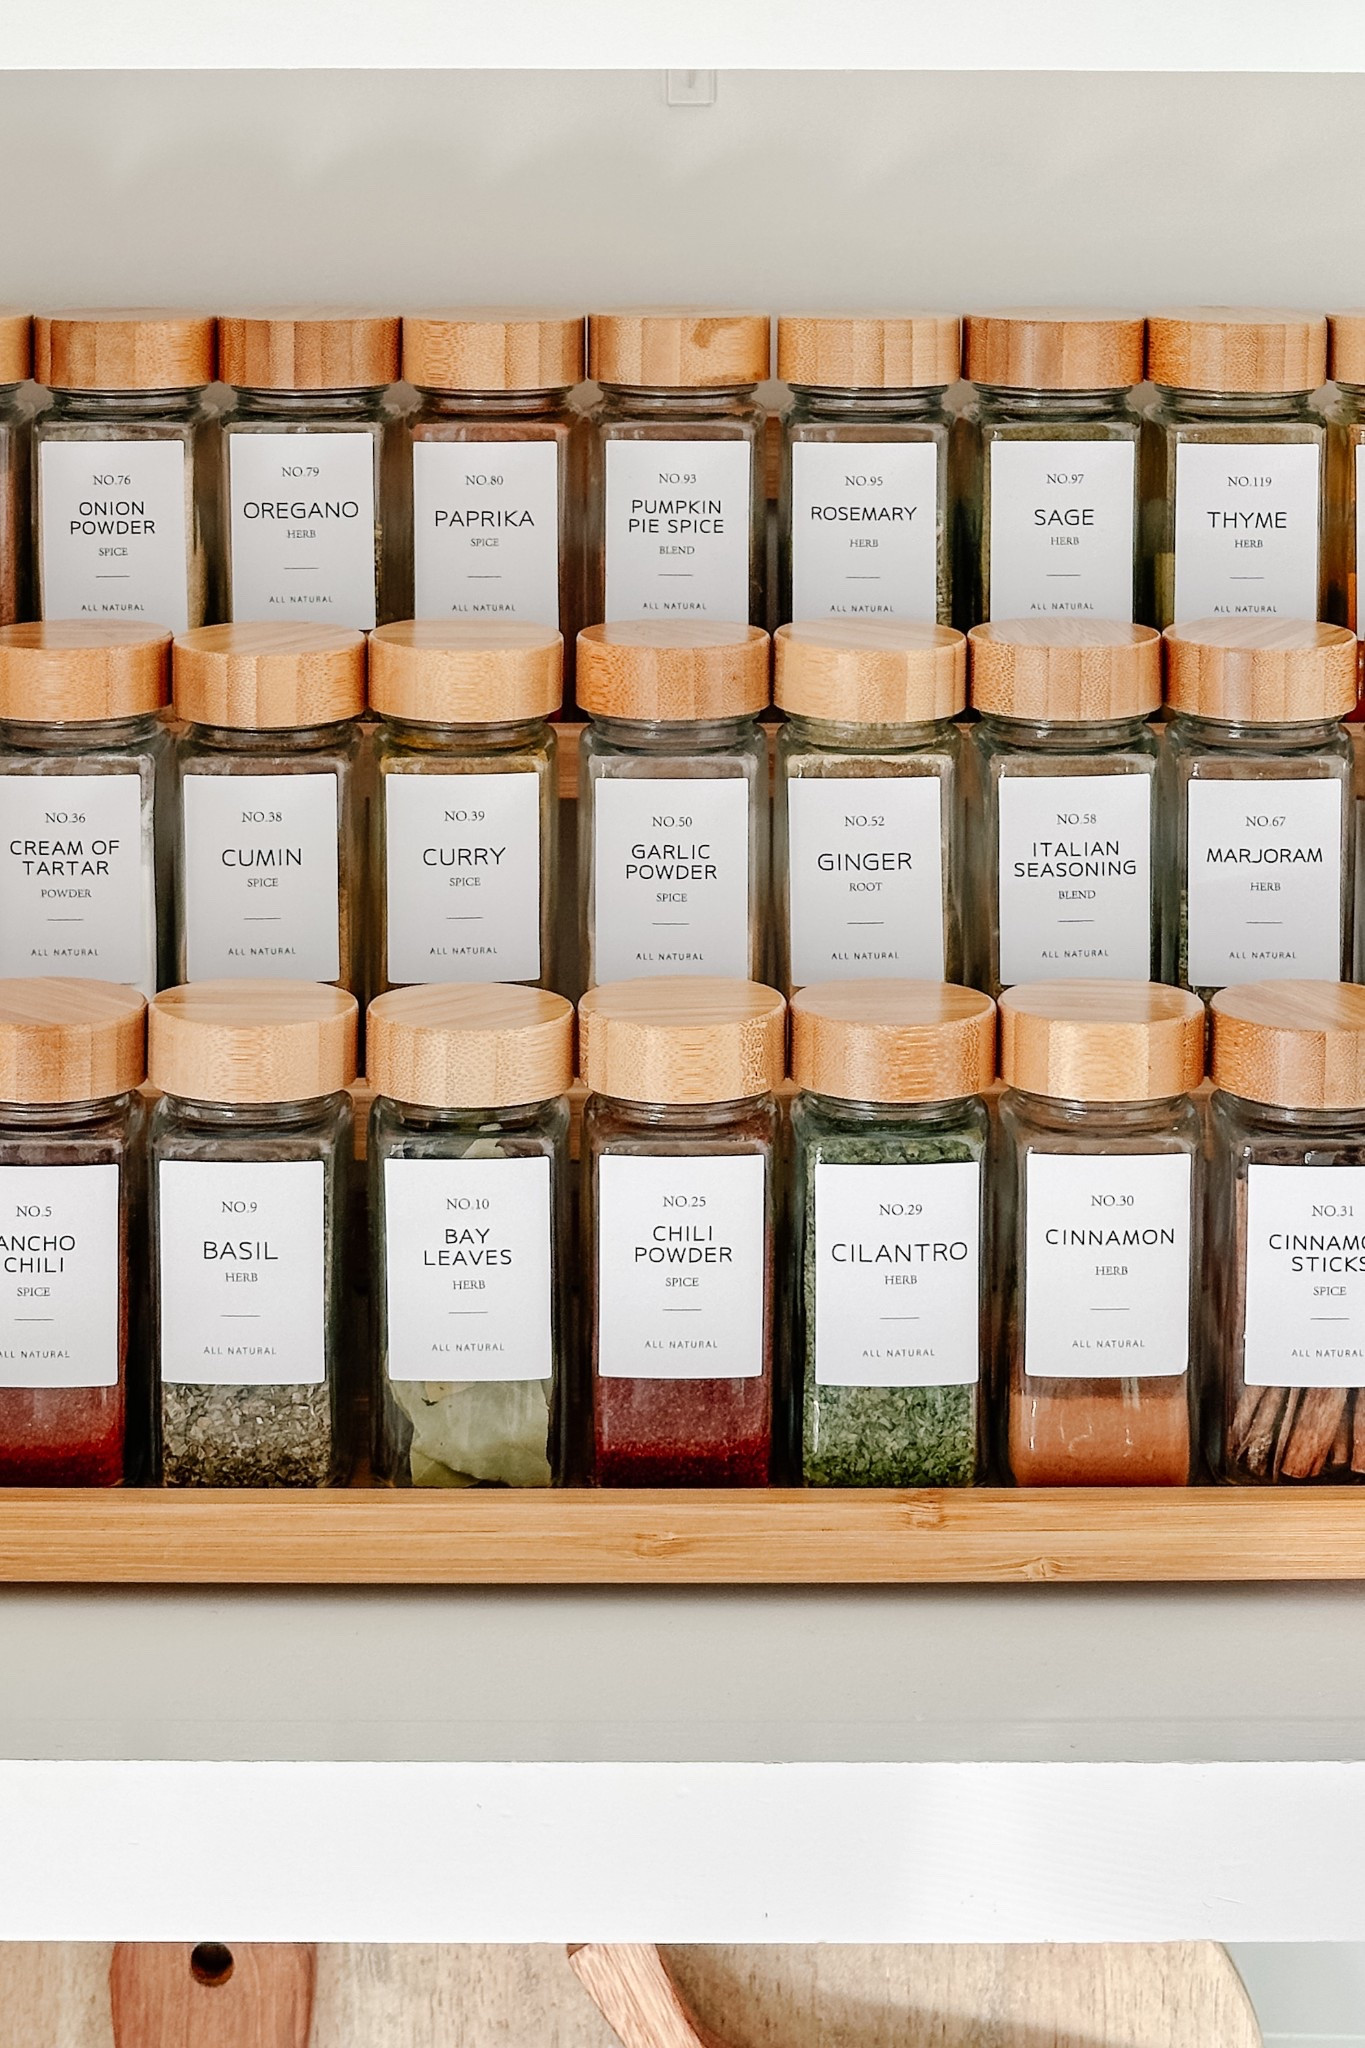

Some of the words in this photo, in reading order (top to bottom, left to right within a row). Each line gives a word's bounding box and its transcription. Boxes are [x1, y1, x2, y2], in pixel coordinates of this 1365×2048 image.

[281, 466, 320, 478] NO.79
[92, 474, 132, 486] NO.76
[465, 474, 504, 486] NO.80
[658, 472, 697, 485] NO.93
[844, 475, 884, 487] NO.95
[1046, 473, 1085, 485] NO.97
[1227, 475, 1273, 488] NO.119
[78, 500, 145, 517] ONION
[243, 500, 359, 520] OREGANO
[631, 499, 722, 515] PUMPKIN
[434, 509, 535, 528] PAPRIKA
[810, 505, 918, 522] ROSEMARY
[1033, 508, 1095, 527] SAGE
[628, 518, 660, 534] PIE
[667, 518, 725, 534] SPICE
[1206, 511, 1288, 529] THYME
[69, 519, 156, 536] POWDER
[286, 529, 317, 539] HERB
[470, 537, 499, 548] SPICE
[849, 538, 879, 548] HERB
[1050, 536, 1080, 546] HERB
[1234, 539, 1264, 549] HERB
[98, 547, 129, 557] SPICE
[659, 545, 696, 555] BLEND
[268, 595, 286, 604] ALL
[289, 595, 333, 604] NATURAL
[81, 604, 98, 612] ALL
[101, 603, 145, 612] NATURAL
[451, 604, 469, 612] ALL
[472, 603, 516, 612] NATURAL
[642, 602, 659, 610] ALL
[663, 602, 707, 610] NATURAL
[830, 604, 847, 613] ALL
[850, 604, 893, 613] NATURAL
[1030, 602, 1047, 611] ALL
[1051, 602, 1094, 611] NATURAL
[1213, 605, 1231, 614] ALL
[1234, 605, 1277, 614] NATURAL
[44, 812, 86, 824] NO.36
[241, 811, 283, 823] NO.38
[444, 810, 486, 822] NO.39
[652, 815, 693, 828] NO.50
[844, 815, 886, 827] NO.52
[1056, 813, 1097, 826] NO.58
[1245, 815, 1287, 828] NO.67
[9, 839, 84, 857] CREAM
[91, 839, 121, 856] OF
[631, 843, 711, 860] GARLIC
[1032, 840, 1119, 858] ITALIAN
[221, 847, 302, 867] CUMIN
[422, 846, 507, 867] CURRY
[1206, 847, 1323, 864] MARJORAM
[817, 852, 913, 872] GINGER
[21, 860, 110, 877] TARTAR
[625, 864, 718, 881] POWDER
[1013, 859, 1137, 878] SEASONING
[246, 877, 279, 888] SPICE
[449, 876, 481, 887] SPICE
[849, 881, 883, 892] ROOT
[1250, 881, 1281, 892] HERB
[40, 888, 93, 899] POWDER
[655, 892, 688, 903] SPICE
[1058, 889, 1097, 900] BLEND
[30, 948, 49, 957] ALL
[53, 948, 98, 957] NATURAL
[228, 947, 246, 956] ALL
[250, 947, 296, 956] NATURAL
[429, 947, 448, 956] ALL
[451, 946, 498, 955] NATURAL
[635, 952, 654, 961] ALL
[658, 952, 704, 961] NATURAL
[831, 952, 849, 961] ALL
[853, 951, 898, 960] NATURAL
[1041, 950, 1059, 959] ALL
[1063, 949, 1109, 958] NATURAL
[1229, 951, 1246, 960] ALL
[1251, 951, 1296, 960] NATURAL
[446, 1197, 490, 1211] NO.10
[662, 1195, 707, 1208] NO.25
[1090, 1194, 1135, 1207] NO.30
[15, 1205, 53, 1218] NO.5
[221, 1200, 258, 1214] NO.9
[878, 1203, 923, 1217] NO.29
[1311, 1204, 1354, 1218] NO.31
[444, 1227, 491, 1245] BAY
[652, 1224, 713, 1243] CHILI
[1045, 1227, 1175, 1247] CINNAMON
[1268, 1233, 1365, 1252] CINNAM
[203, 1240, 279, 1261] BASIL
[634, 1246, 733, 1264] POWDER
[831, 1241, 968, 1264] CILANTRO
[423, 1248, 513, 1267] LEAVES
[3, 1256, 64, 1274] CHILI
[1095, 1265, 1129, 1276] HERB
[224, 1271, 259, 1283] HERB
[665, 1276, 700, 1288] SPICE
[884, 1274, 918, 1286] HERB
[452, 1279, 486, 1291] HERB
[1312, 1285, 1347, 1297] SPICE
[16, 1286, 51, 1297] SPICE
[431, 1343, 451, 1352] ALL
[455, 1343, 505, 1352] NATURAL
[644, 1340, 664, 1349] ALL
[668, 1340, 718, 1349] NATURAL
[1071, 1339, 1092, 1349] ALL
[1096, 1339, 1145, 1349] NATURAL
[20, 1350, 70, 1359] NATURAL
[203, 1346, 223, 1355] ALL
[227, 1346, 277, 1356] NATURAL
[862, 1349, 881, 1358] ALL
[886, 1348, 935, 1358] NATURAL
[1291, 1348, 1311, 1358] ALL
[1315, 1349, 1364, 1358] NATURAL
